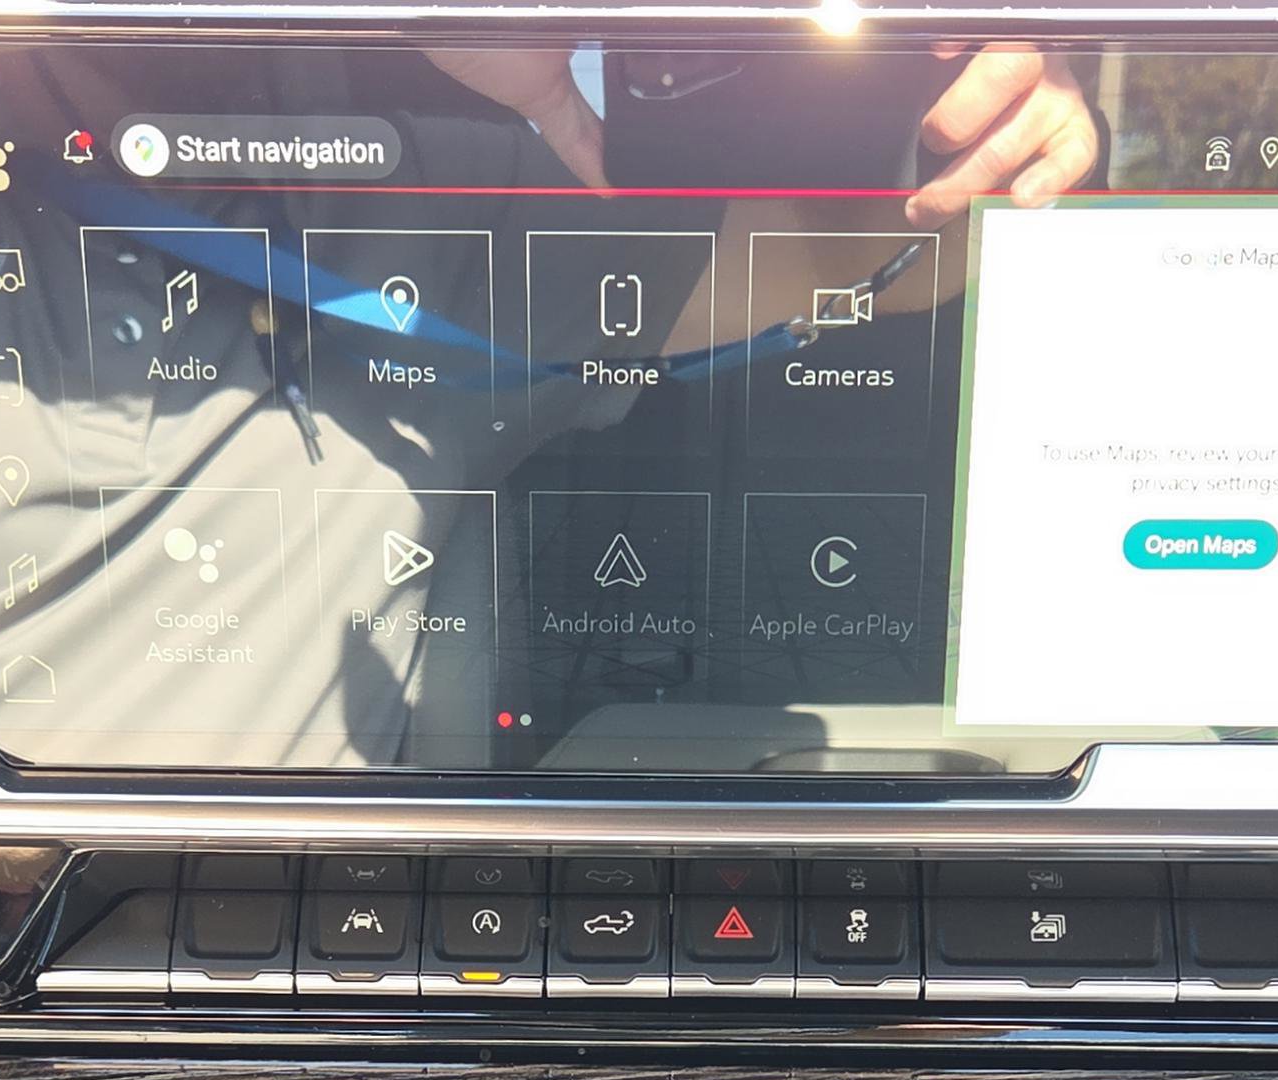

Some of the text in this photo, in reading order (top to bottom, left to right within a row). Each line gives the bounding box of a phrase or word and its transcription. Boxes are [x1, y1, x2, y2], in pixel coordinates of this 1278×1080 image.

[176, 134, 385, 170] Start navigation
[1161, 246, 1234, 272] Gogle
[146, 356, 218, 381] Audio
[368, 359, 438, 389] Maps
[582, 361, 659, 385] Phone
[784, 362, 895, 387] Cameras
[1236, 449, 1276, 467] your
[1131, 477, 1201, 495] privacy
[1144, 534, 1258, 559] Open Maps
[154, 607, 240, 636] Google
[351, 609, 467, 637] Play Store
[542, 611, 697, 635] Android Auto
[748, 613, 915, 643] Apple CarPlay
[144, 641, 255, 664] Assistant
[847, 931, 868, 944] OFF
